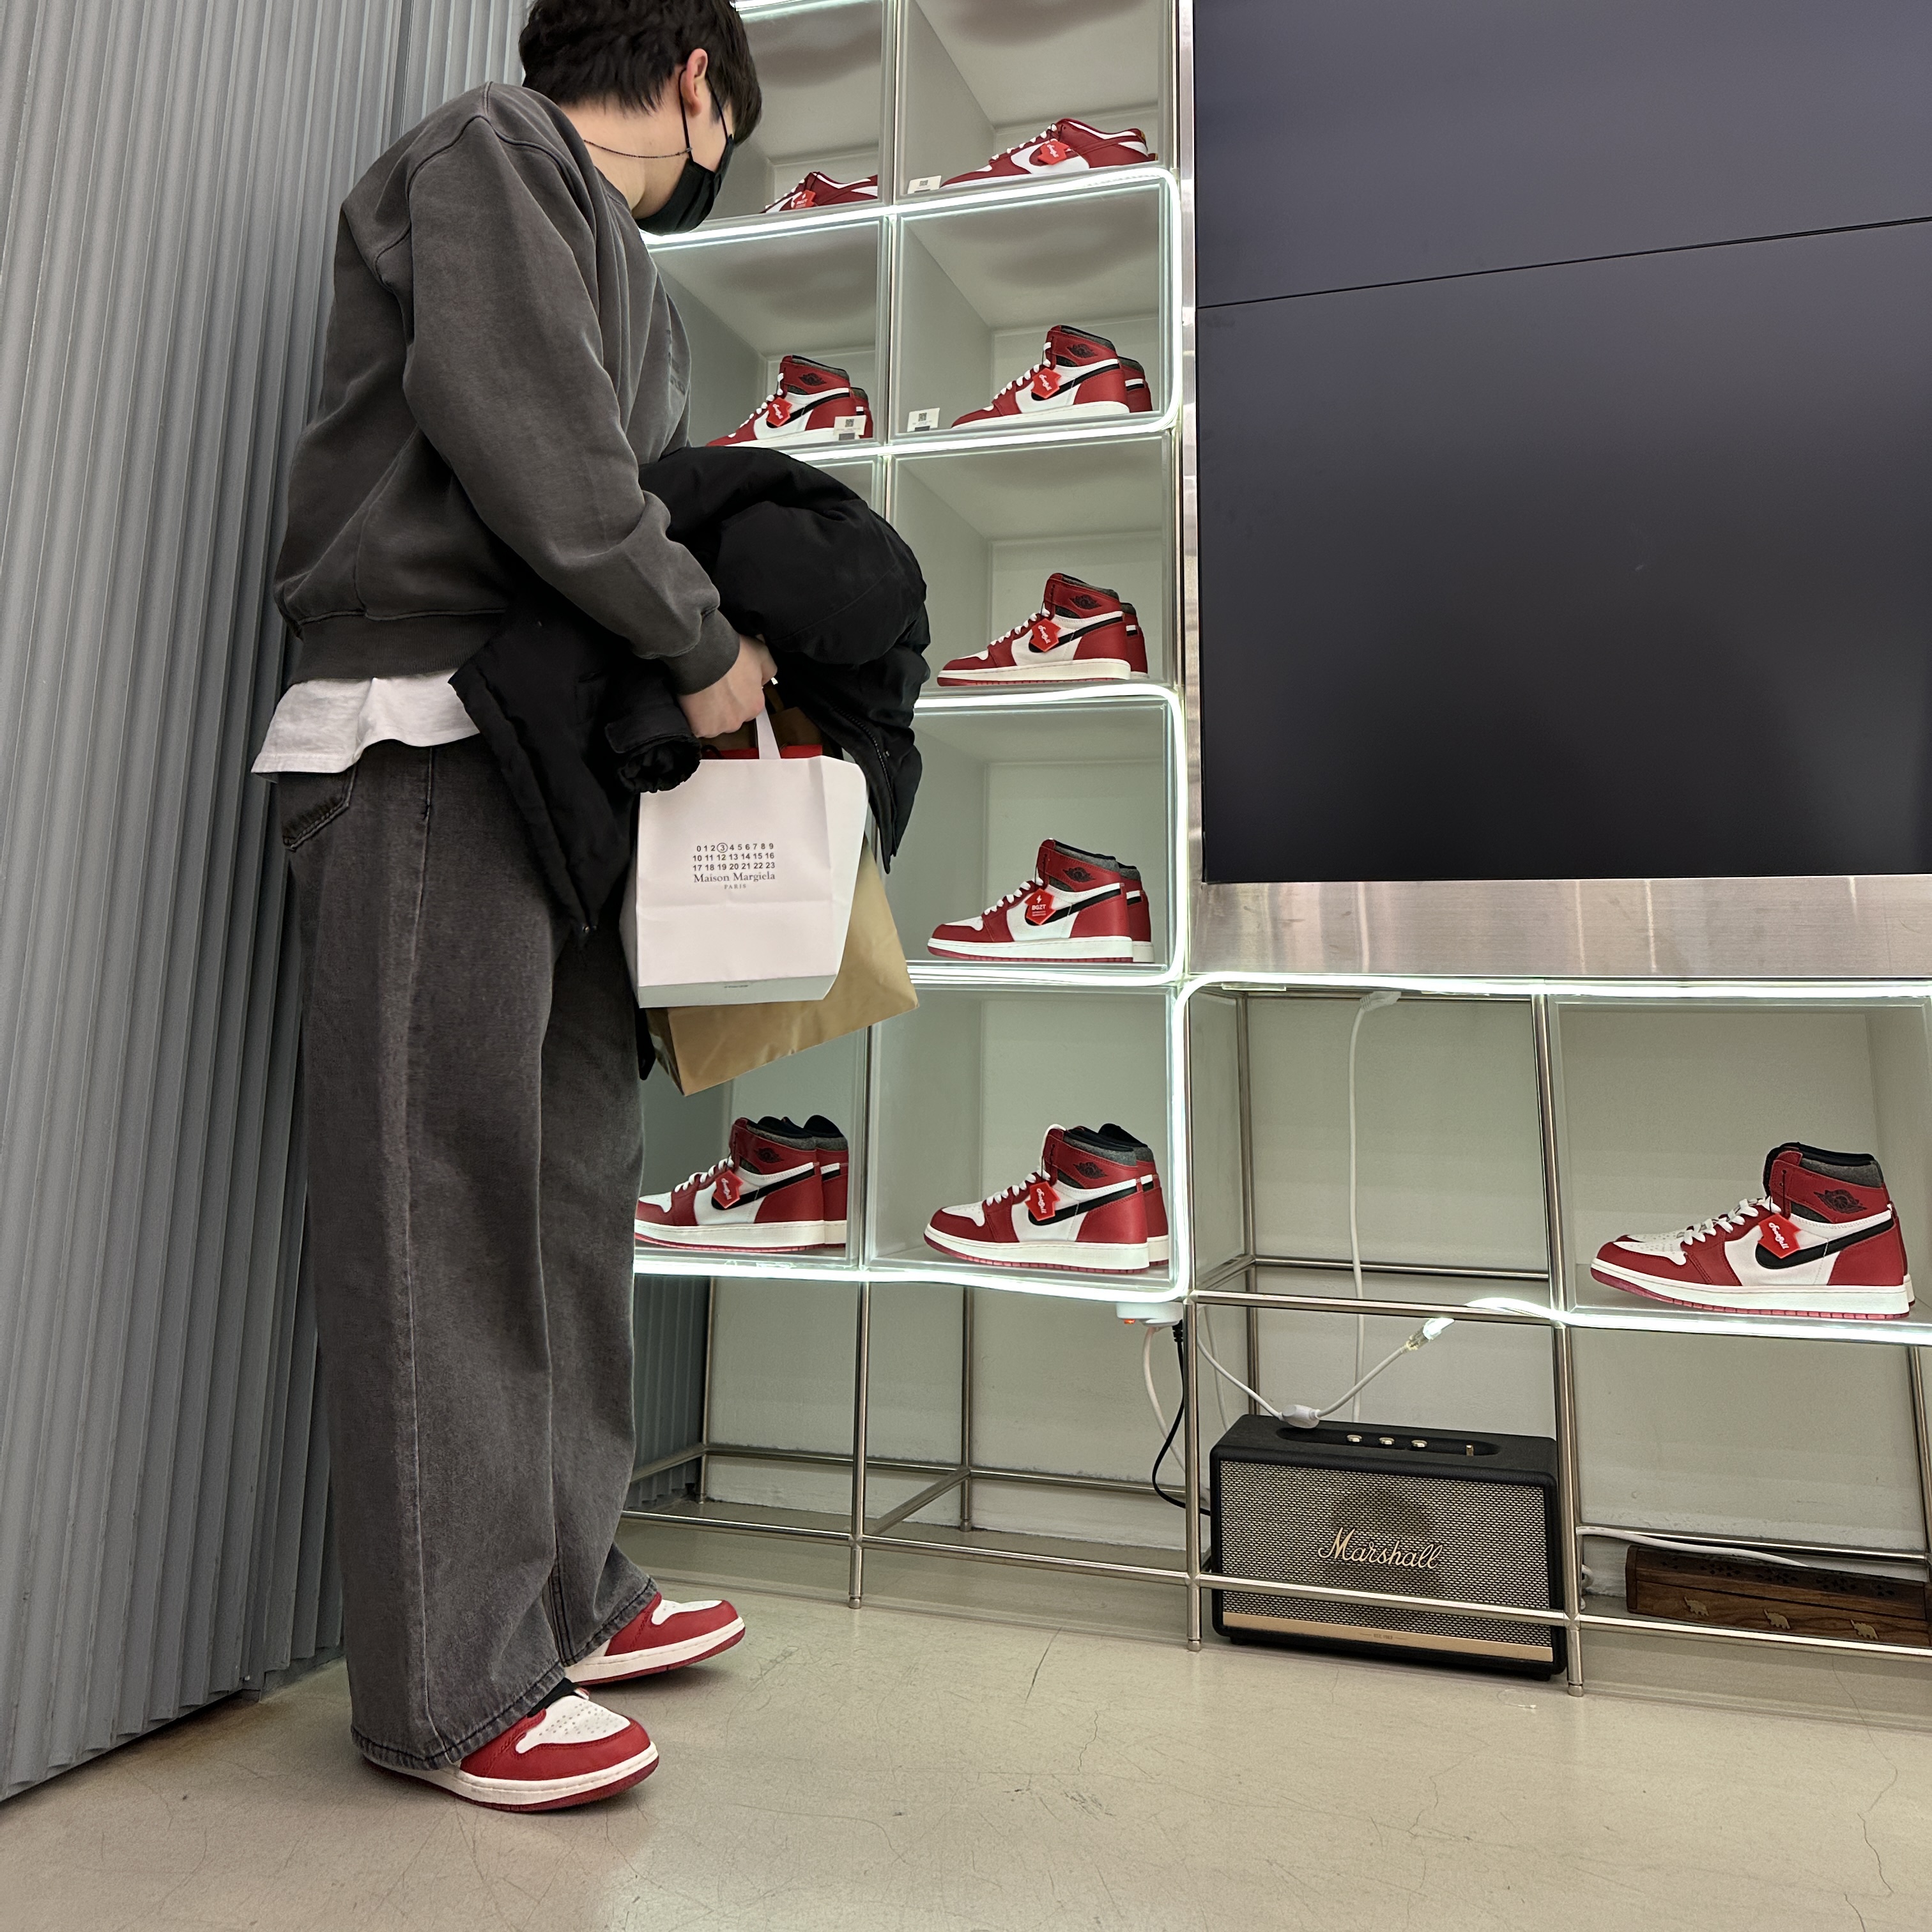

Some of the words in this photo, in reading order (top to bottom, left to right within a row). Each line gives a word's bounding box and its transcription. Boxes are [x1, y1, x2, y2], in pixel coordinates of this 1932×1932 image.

[693, 873, 730, 883] Maison
[733, 871, 776, 882] Margiela
[1317, 1526, 1443, 1569] Marshall
